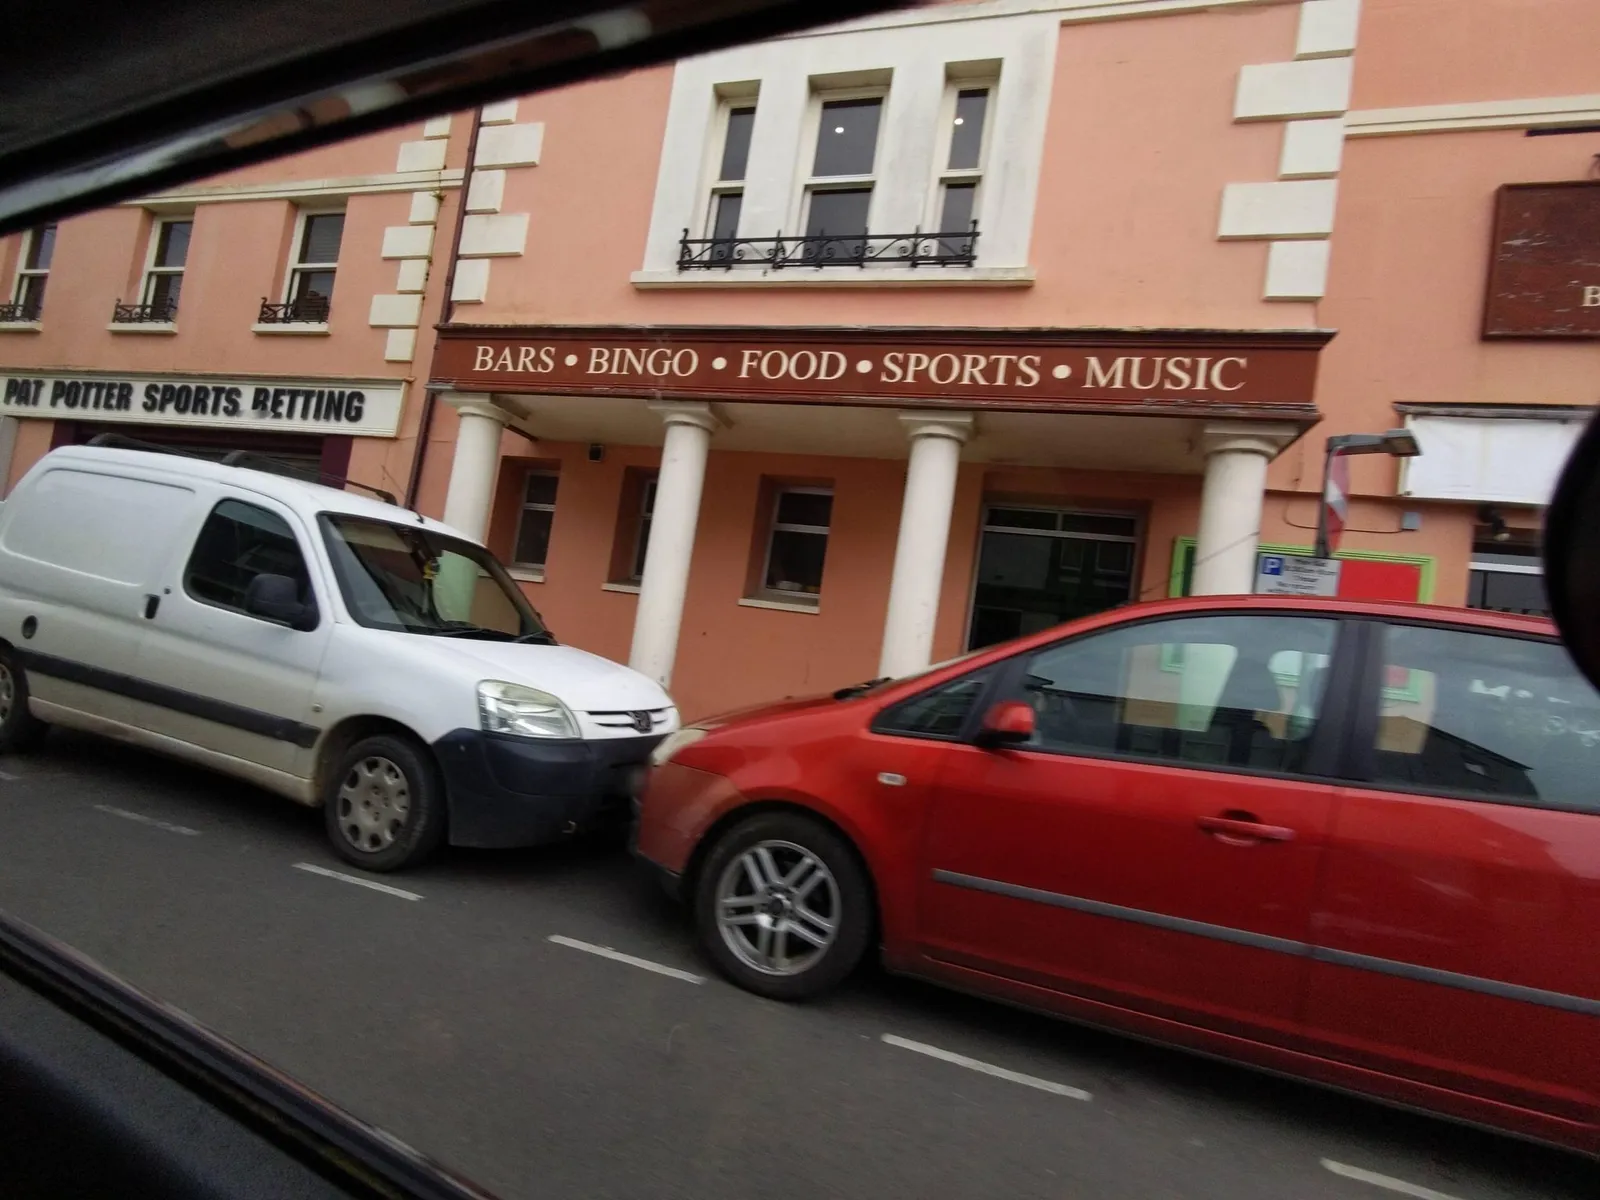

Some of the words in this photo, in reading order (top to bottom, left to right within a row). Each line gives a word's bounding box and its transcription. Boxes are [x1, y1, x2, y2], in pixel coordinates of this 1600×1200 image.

[473, 346, 555, 373] BARS
[585, 348, 699, 376] BINGO
[737, 350, 847, 380] FOOD
[880, 352, 1041, 387] SPORTS
[1081, 356, 1248, 391] MUSIC
[5, 379, 44, 407] PAT
[50, 381, 133, 410] POTTER
[142, 384, 242, 417] SPORTS
[251, 388, 365, 423] BETTING
[1264, 558, 1281, 574] P
